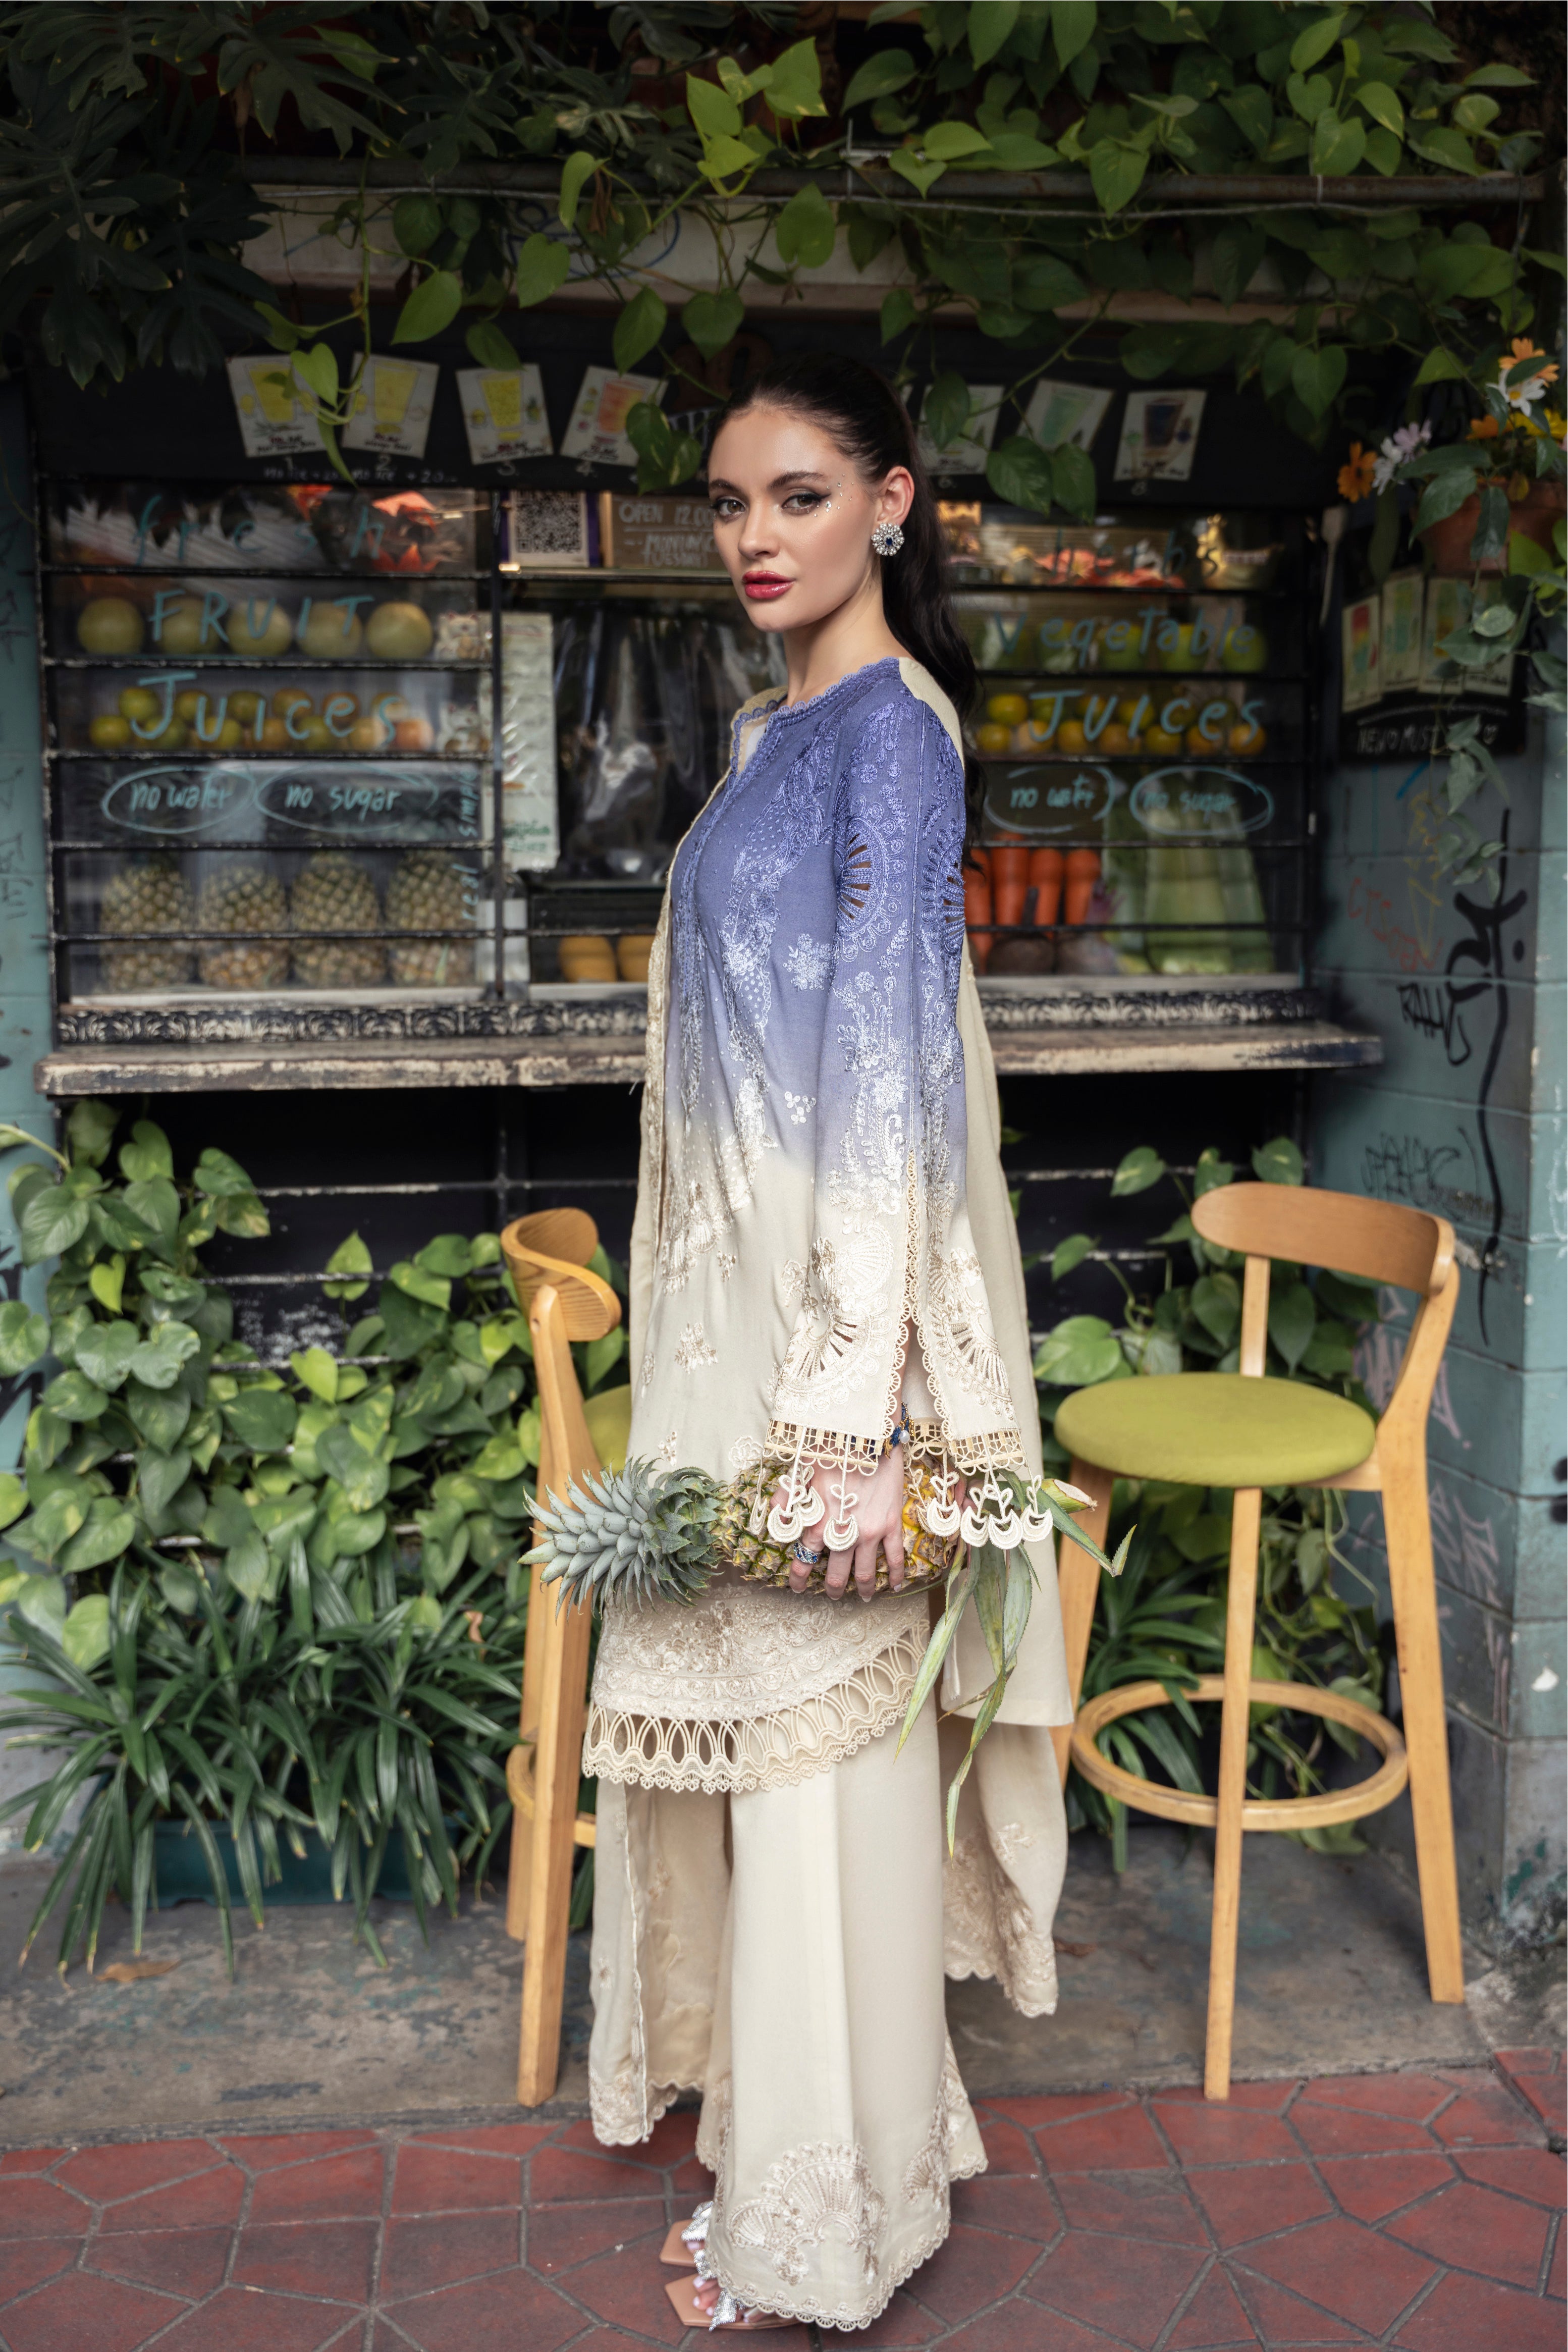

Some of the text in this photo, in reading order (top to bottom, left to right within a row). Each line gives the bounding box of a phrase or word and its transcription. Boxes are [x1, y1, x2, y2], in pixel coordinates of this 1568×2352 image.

[133, 494, 386, 565] fresh
[618, 500, 664, 523] OPEN
[149, 589, 374, 643] FRUIT
[132, 773, 233, 812] no water
[285, 784, 401, 822] no sugar
[1010, 786, 1038, 808] no
